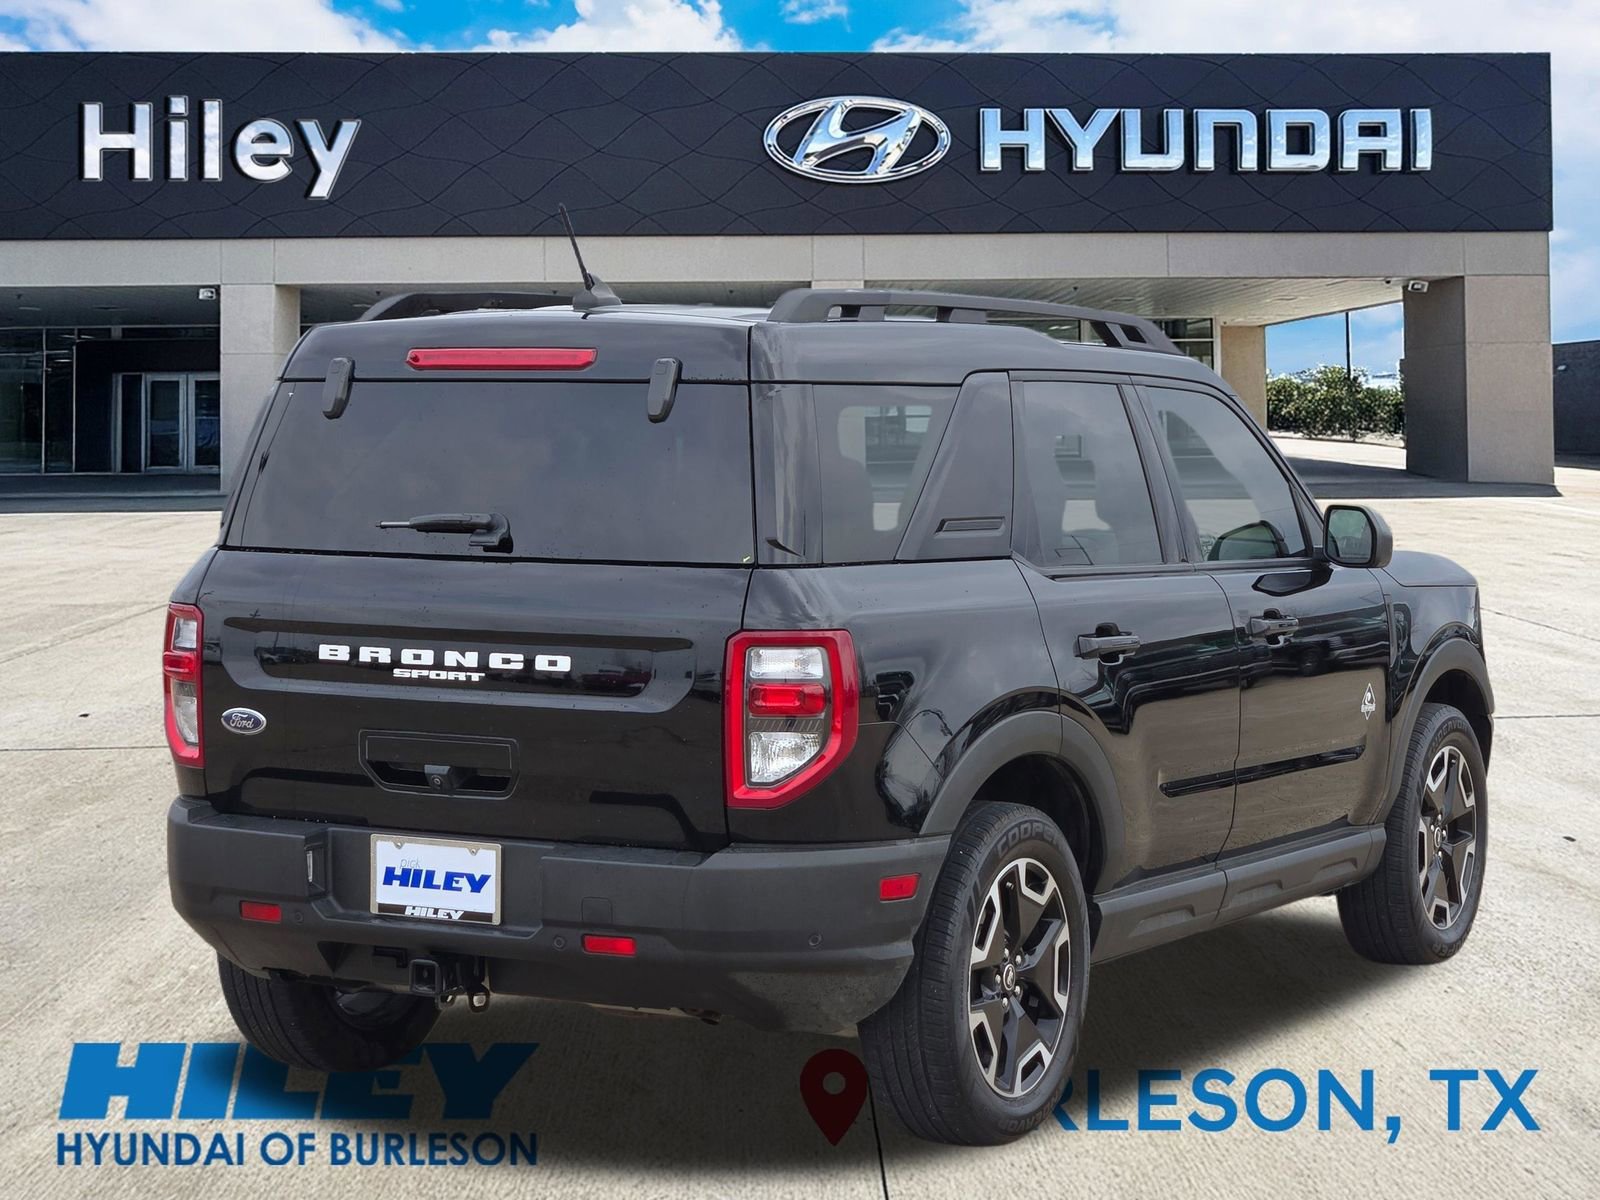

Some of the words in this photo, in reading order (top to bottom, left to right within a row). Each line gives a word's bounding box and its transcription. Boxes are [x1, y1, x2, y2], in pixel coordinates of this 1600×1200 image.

[79, 95, 362, 201] Hiley
[979, 107, 1433, 173] HYUNDAI
[318, 643, 572, 672] BRONCO
[392, 667, 486, 682] SPORT
[229, 712, 255, 729] Ford
[382, 866, 492, 894] HILEY
[404, 905, 465, 921] HILEY
